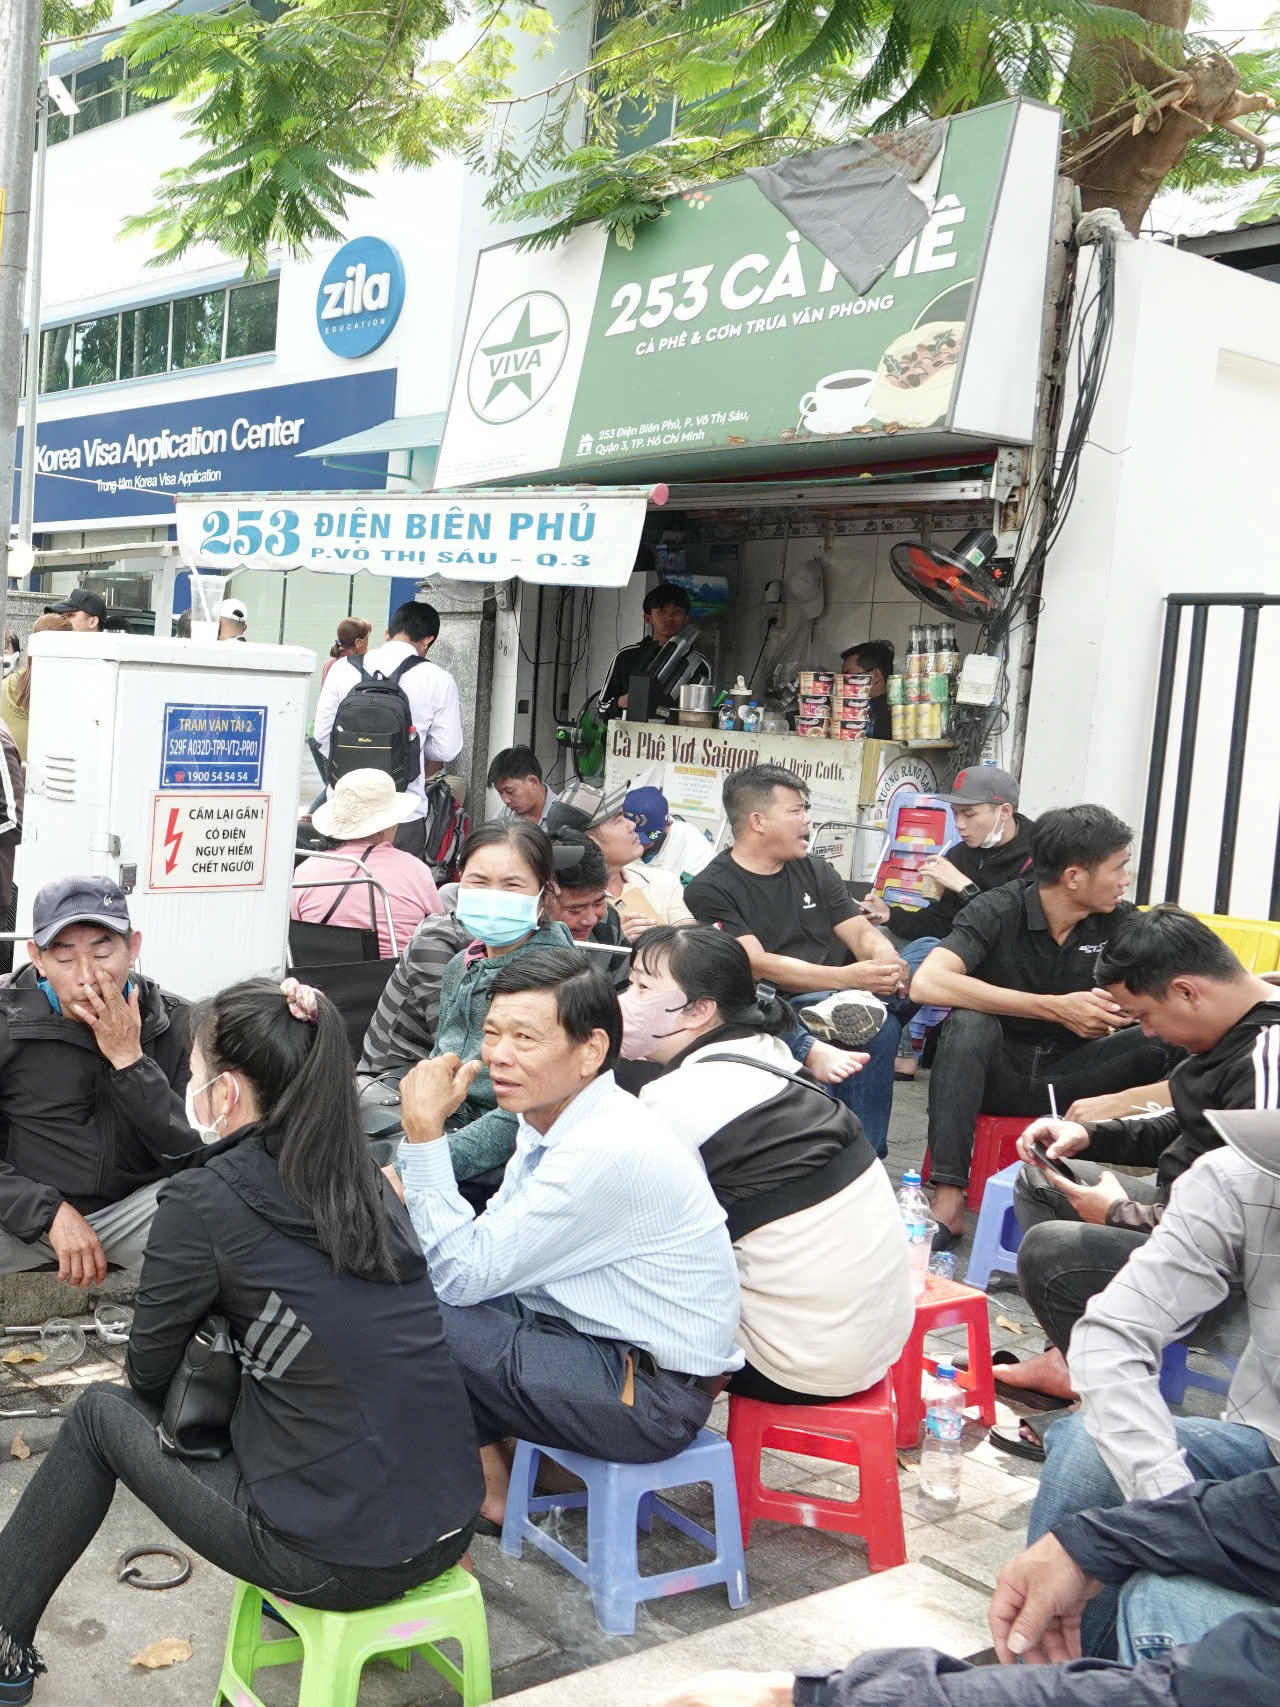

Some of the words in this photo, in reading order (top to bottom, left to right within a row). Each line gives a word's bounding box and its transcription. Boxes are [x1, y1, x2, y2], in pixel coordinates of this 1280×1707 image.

[321, 262, 391, 320] zila
[604, 264, 714, 337] 253
[720, 230, 806, 311] CÀ
[325, 317, 386, 335] EDUCATION
[635, 337, 655, 356] CÀ
[658, 331, 688, 351] PHÊ
[690, 331, 702, 345] &
[706, 322, 742, 342] CƠM
[746, 313, 787, 335] TRƯA
[792, 306, 824, 326] VĂN
[828, 294, 895, 320] PHÒNG
[489, 348, 542, 378] VIVA
[598, 429, 616, 440] 253
[617, 425, 638, 438] Điện
[639, 422, 660, 435] Biên
[684, 417, 694, 428] P.
[728, 409, 750, 422] Sáu,
[36, 445, 81, 473] Korea
[83, 438, 121, 467] Visa
[121, 426, 227, 468] Application
[231, 415, 305, 451] Center
[595, 442, 620, 456] Quận
[620, 439, 629, 451] 3,
[631, 438, 645, 449] TP.
[663, 431, 679, 445] Chí
[681, 428, 705, 443] Minh
[134, 474, 157, 488] Korea
[159, 472, 176, 486] Visa
[177, 469, 222, 487] Application
[200, 508, 301, 557] 253
[313, 506, 392, 544] ĐIỆN
[405, 505, 492, 540] BIÊN
[509, 502, 596, 542] PHỦ
[381, 549, 426, 565] THỊ
[437, 548, 498, 565] SÁU
[536, 552, 591, 568] Q.3
[179, 717, 207, 735] TRẠM
[209, 717, 228, 736] VẬN
[246, 720, 253, 733] 2
[169, 738, 188, 756] S29F
[188, 739, 258, 757] A032D-TPP-VT2-PP01
[613, 729, 632, 757] Cà
[637, 732, 665, 762] Phê
[702, 738, 759, 775] Saigon
[188, 771, 210, 782] 1900
[211, 771, 223, 782] 54
[224, 771, 236, 782] 54
[237, 771, 249, 782] 54
[789, 758, 812, 781] Drip
[901, 765, 922, 780] RANG
[189, 806, 214, 820] CẤM
[217, 809, 234, 823] LẠI
[206, 827, 220, 840] CÓ
[222, 827, 246, 842] ĐIỆN
[196, 846, 226, 857] NGUY
[227, 842, 253, 856] HIỂM
[192, 860, 219, 873] CHẾT
[221, 859, 254, 872] NGƯỜI
